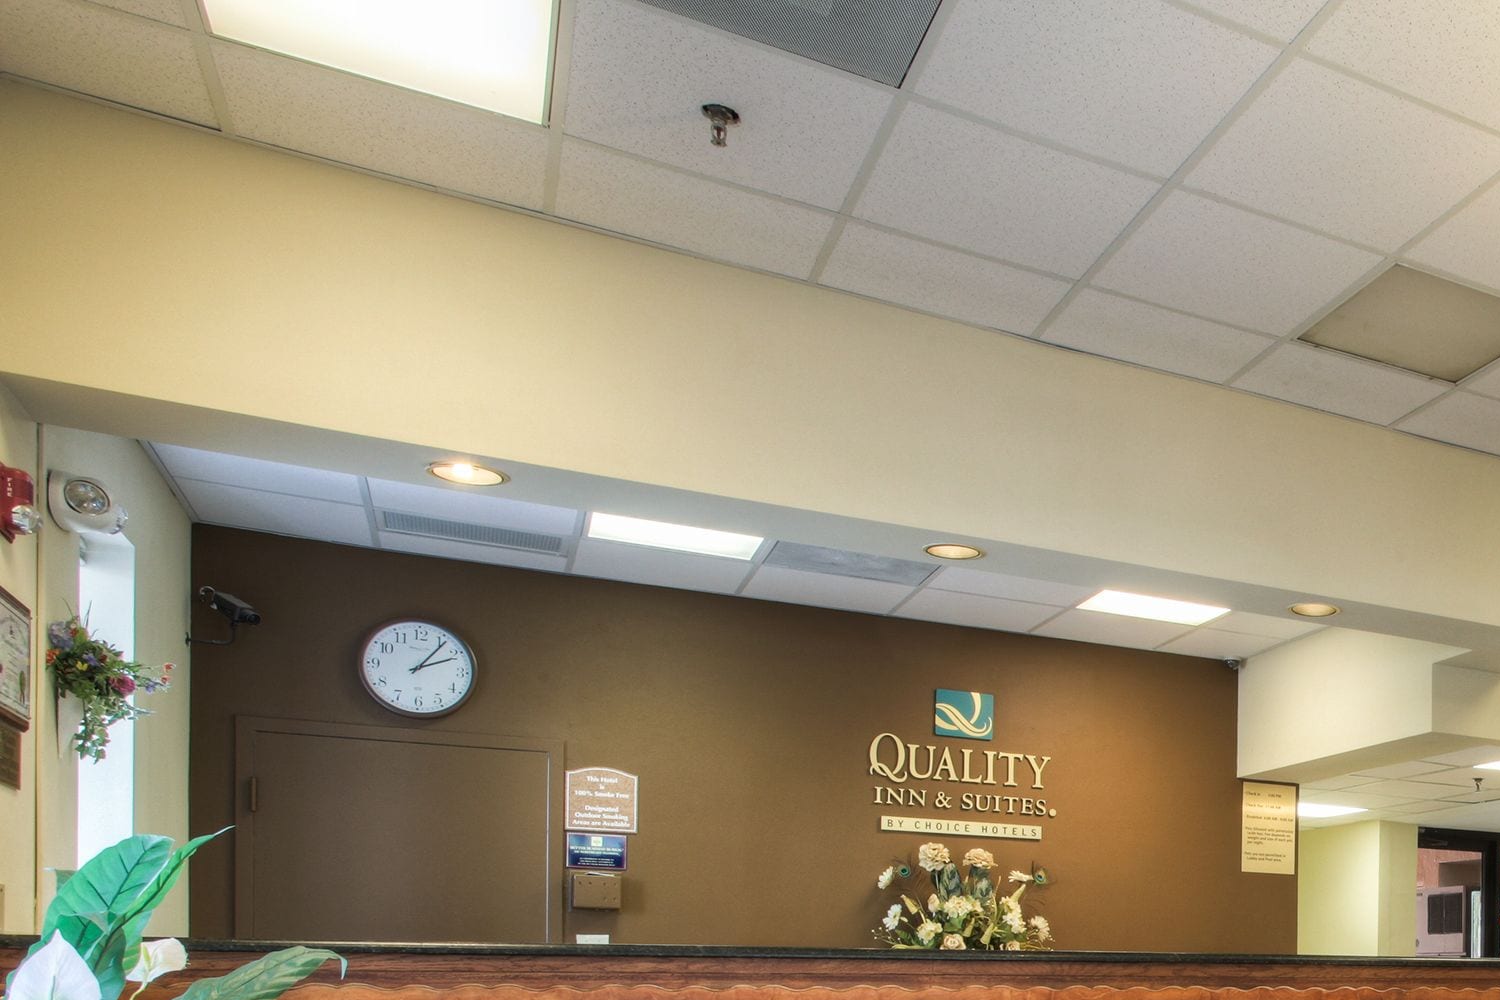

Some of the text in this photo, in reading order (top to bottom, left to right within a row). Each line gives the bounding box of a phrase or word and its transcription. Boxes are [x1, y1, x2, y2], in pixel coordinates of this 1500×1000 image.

[395, 632, 407, 644] 11
[414, 629, 428, 641] 12
[380, 642, 394, 654] 10
[449, 649, 458, 660] 2
[371, 658, 380, 669] 9
[456, 667, 465, 678] 3
[378, 675, 387, 687] 8
[448, 682, 456, 694] 4
[394, 689, 402, 701] 7
[414, 695, 423, 707] 6
[433, 693, 442, 704] 5
[869, 732, 1051, 789] QUALITY
[874, 786, 927, 807] INN
[935, 791, 952, 809] &
[887, 819, 1037, 837] BY CHOICE HOTELS
